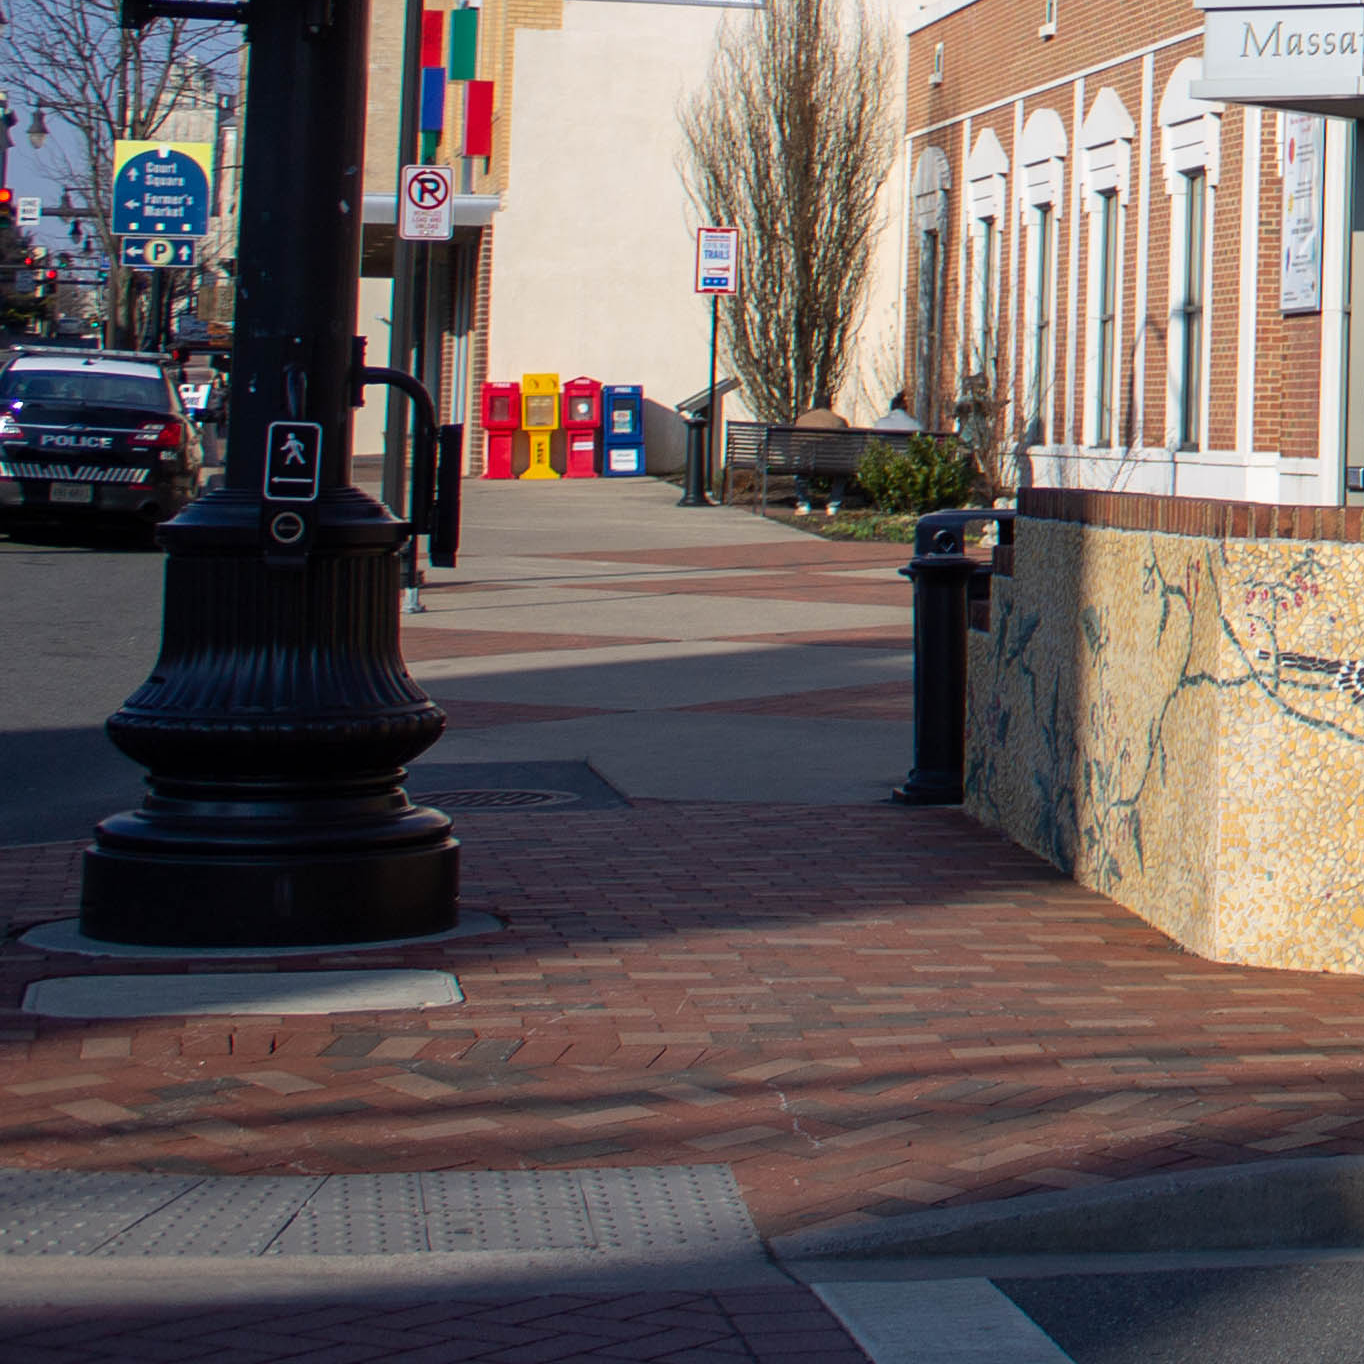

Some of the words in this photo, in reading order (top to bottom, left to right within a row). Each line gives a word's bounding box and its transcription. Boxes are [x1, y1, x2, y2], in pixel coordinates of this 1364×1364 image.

[146, 162, 177, 174] Court
[145, 175, 185, 187] Square
[417, 178, 440, 203] P
[144, 193, 194, 205] Farmer's
[144, 206, 184, 217] Market
[153, 243, 168, 261] P
[41, 435, 114, 448] POLICE
